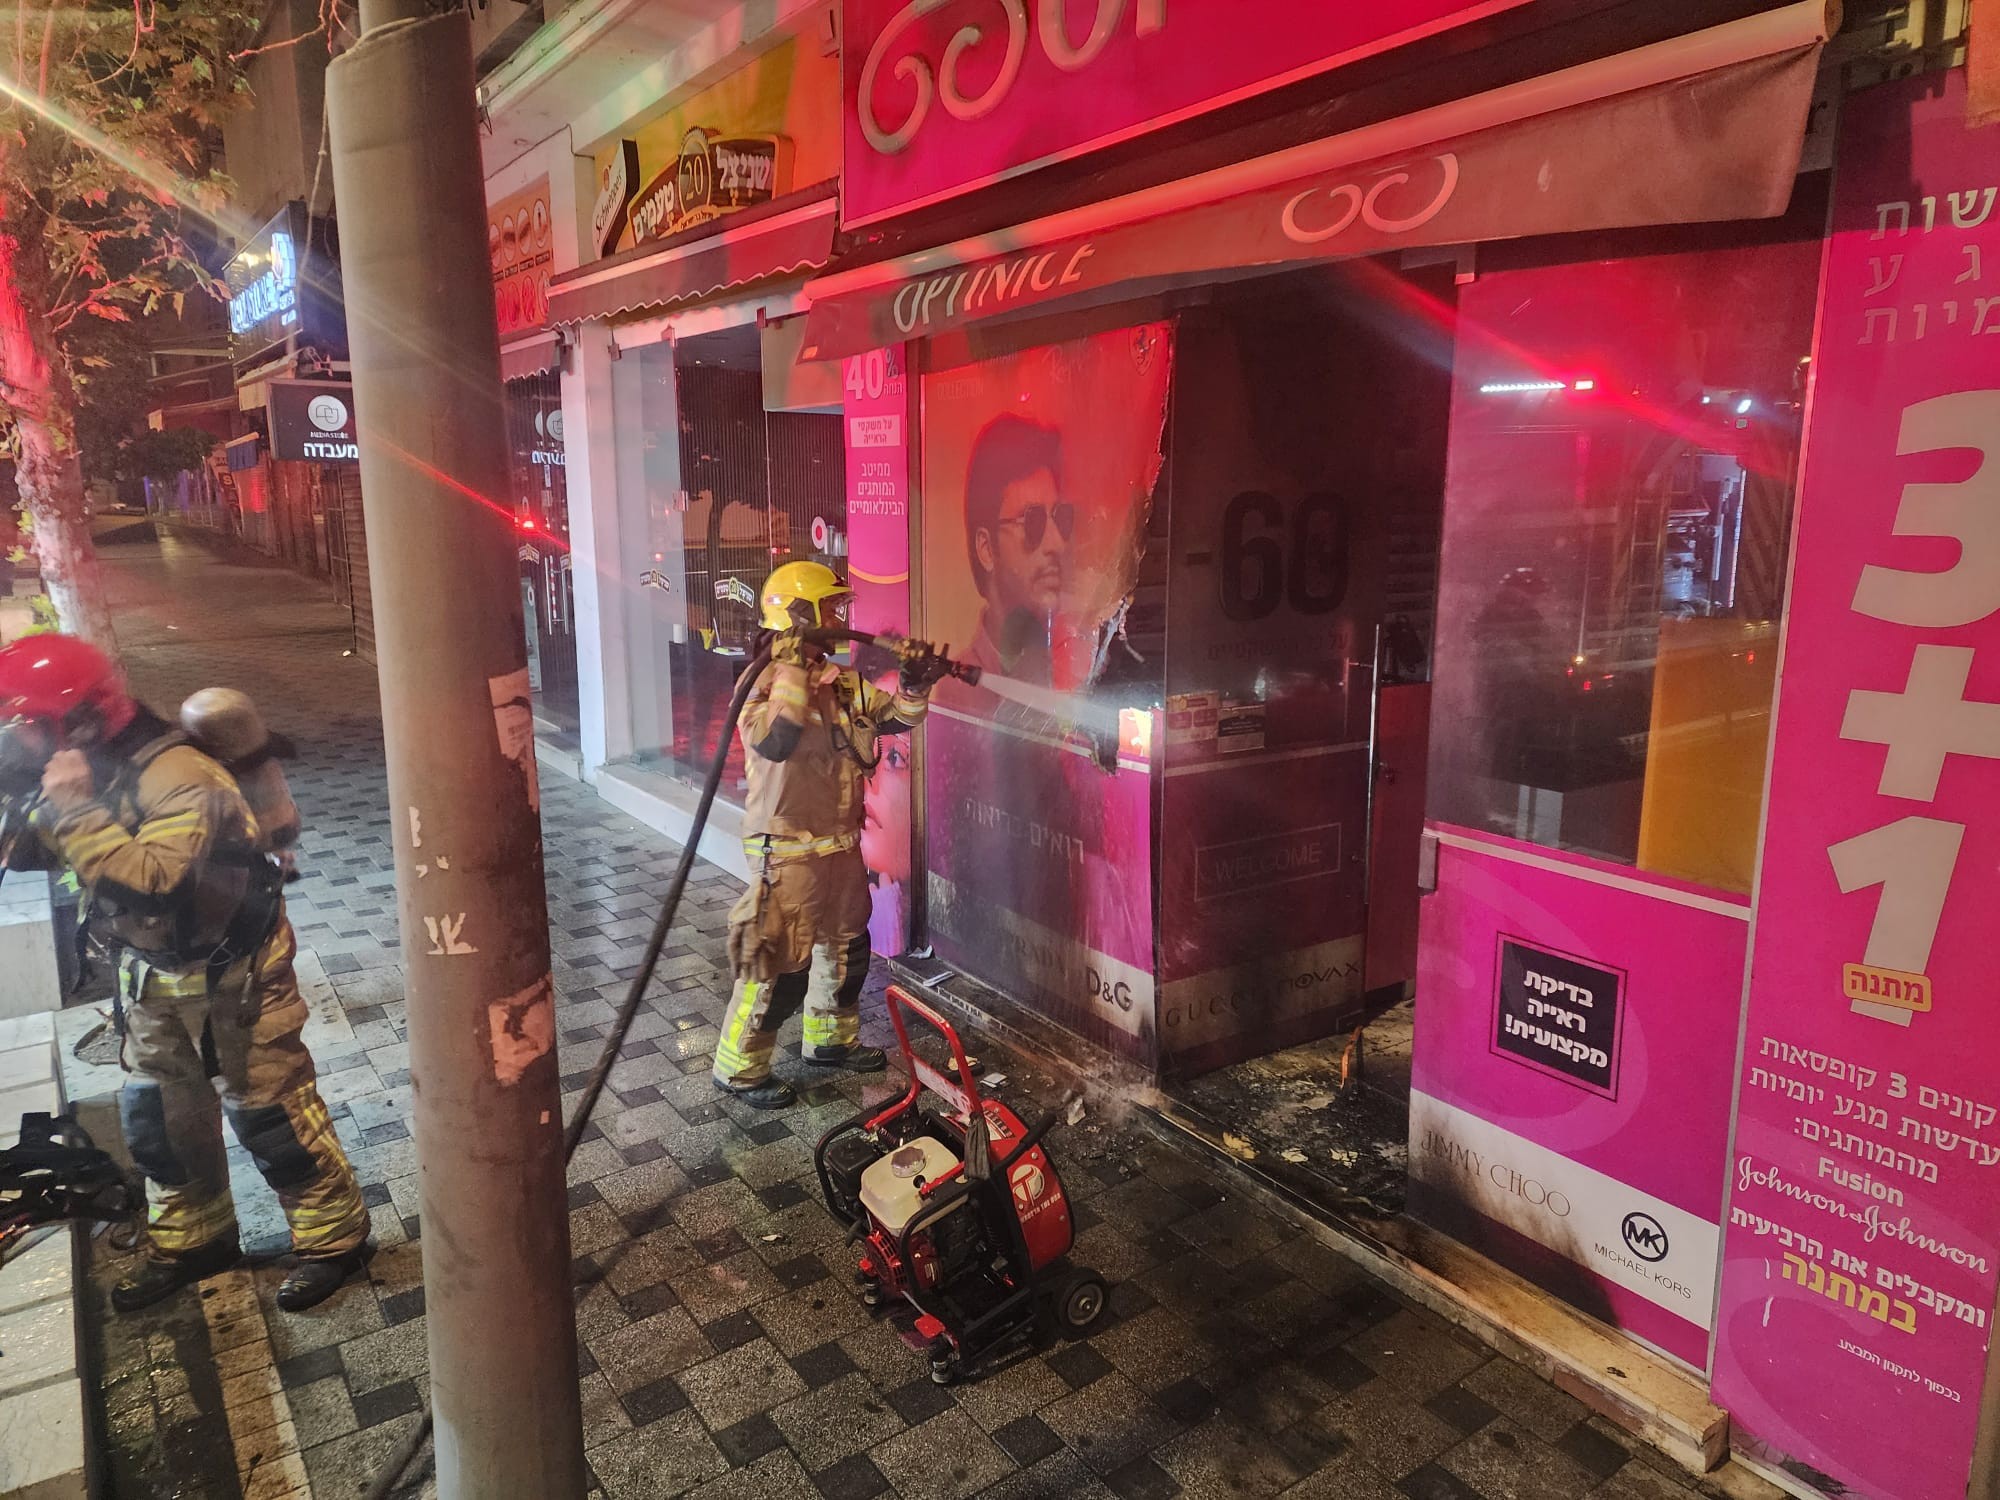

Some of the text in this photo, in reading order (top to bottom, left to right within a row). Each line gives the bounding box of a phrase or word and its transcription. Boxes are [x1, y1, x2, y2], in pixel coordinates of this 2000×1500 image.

[684, 155, 704, 200] 20
[303, 442, 359, 459] מעבדה
[861, 463, 891, 477] ממיטב
[850, 500, 905, 516] הבינלאומיים
[1851, 389, 2000, 628] 3
[1827, 815, 1966, 1028] 1
[1087, 966, 1134, 1012] D&G
[1524, 969, 1594, 1009] בדיקת
[1850, 970, 1925, 1004] מתנה
[1527, 997, 1586, 1033] ראייה
[1505, 1014, 1608, 1068] מקצועית!
[1760, 1036, 1997, 1129] קונים 3 קופסאות
[1749, 1067, 2000, 1166] עדשות מגע יומיות
[1420, 1129, 1572, 1218] JIMMY CHOO
[1793, 1116, 1938, 1184] מהמותגים:
[1818, 1156, 1905, 1207] Fusion
[1626, 1219, 1665, 1255] MK
[1594, 1242, 1692, 1300] MICHAEL KORS
[1730, 1207, 1986, 1328] ומקבלים את הרביעית
[1782, 1251, 1917, 1335] במתנה
[1837, 1338, 1881, 1366] המבצע
[1883, 1359, 1921, 1383] לתקנון
